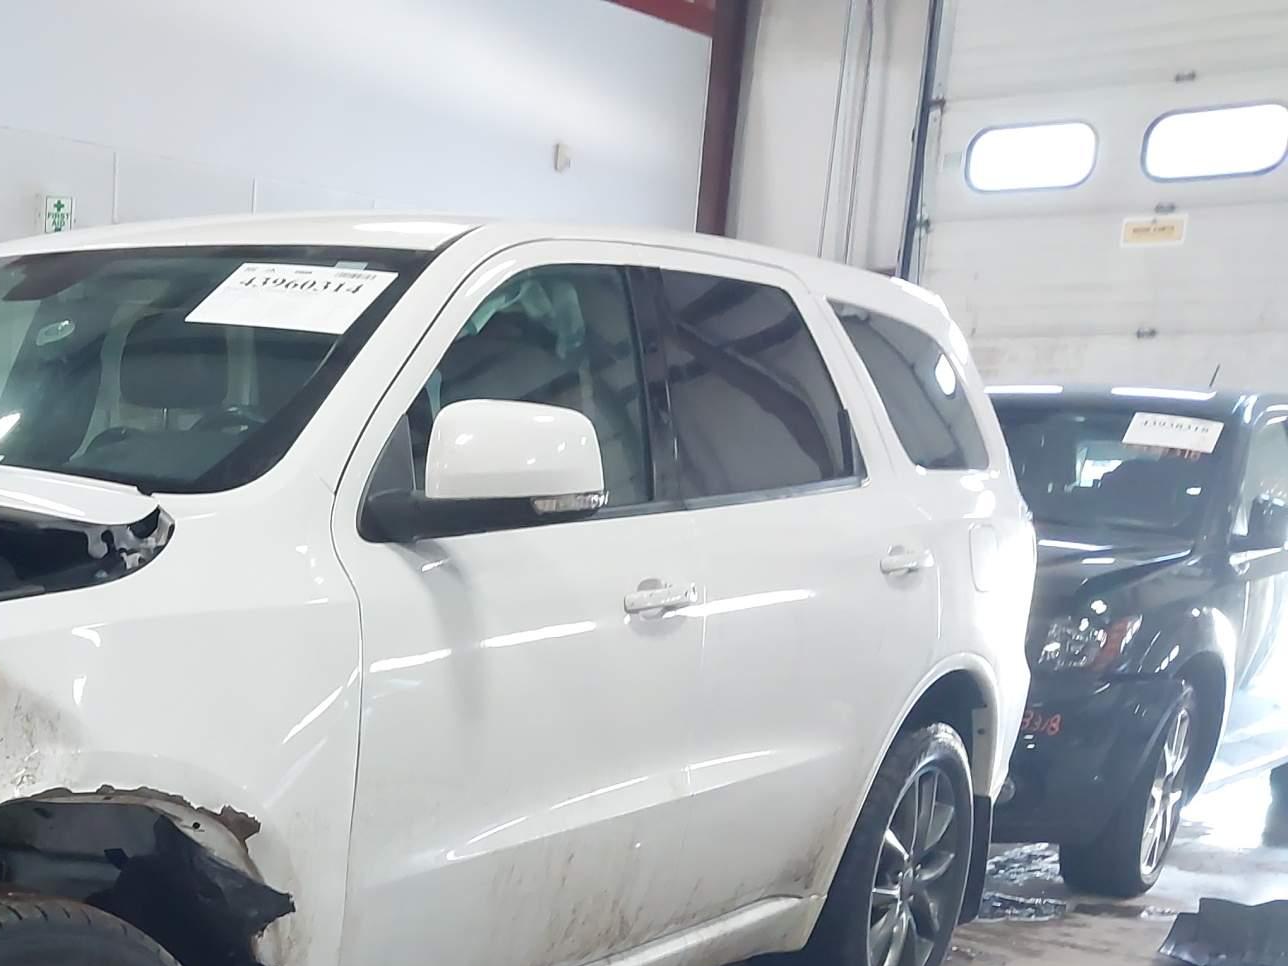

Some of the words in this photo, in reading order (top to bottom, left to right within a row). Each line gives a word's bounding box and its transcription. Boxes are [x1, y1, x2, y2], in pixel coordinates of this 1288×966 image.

[48, 212, 69, 221] FIRST
[51, 219, 66, 228] AID
[240, 276, 364, 294] 43960314
